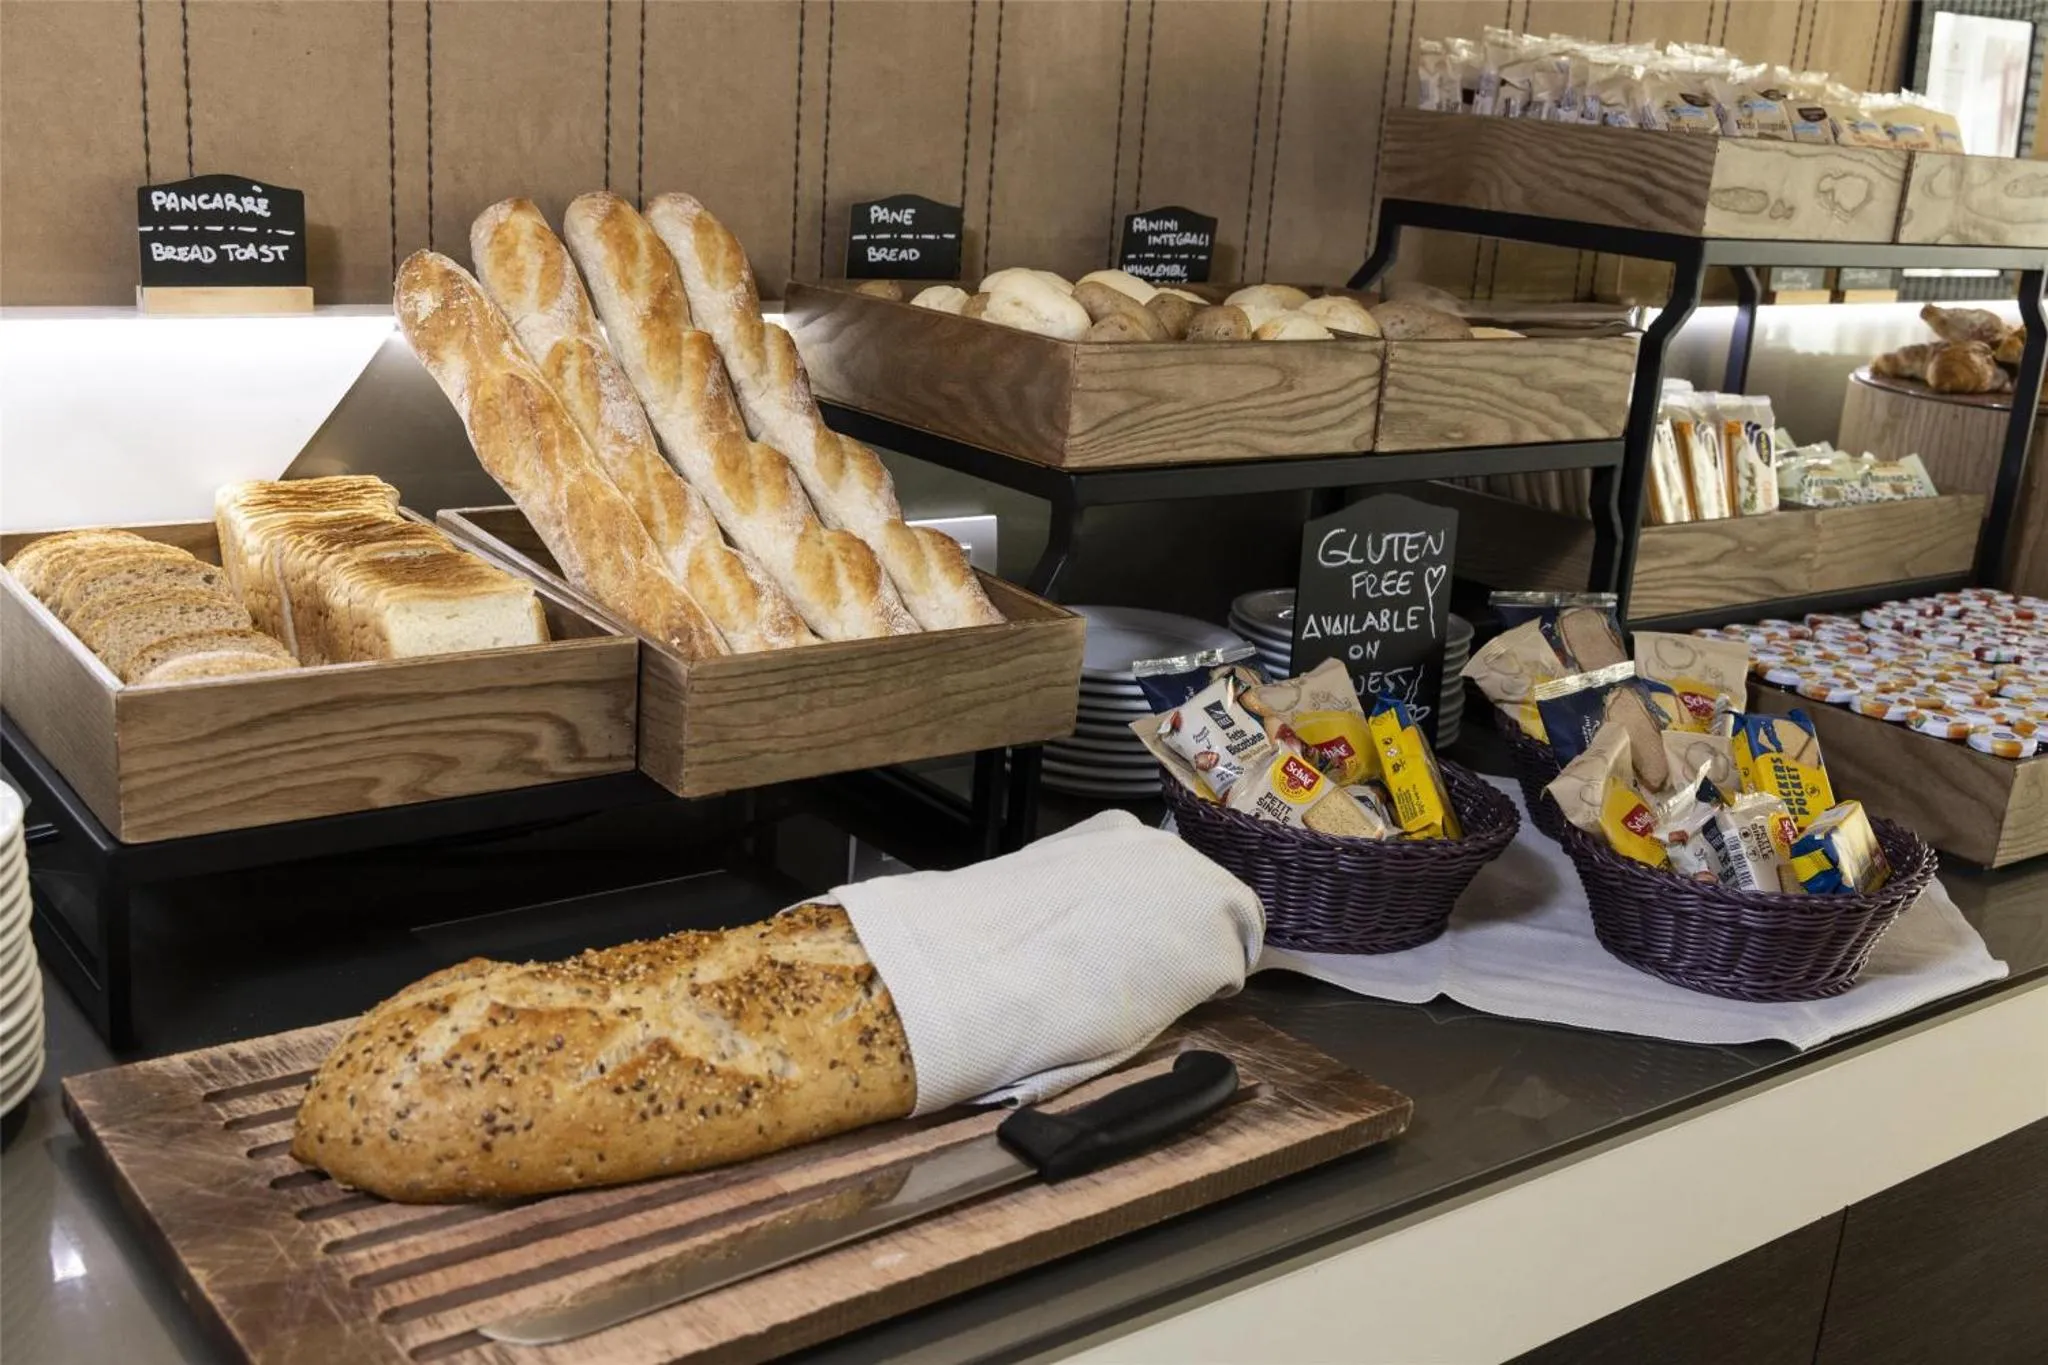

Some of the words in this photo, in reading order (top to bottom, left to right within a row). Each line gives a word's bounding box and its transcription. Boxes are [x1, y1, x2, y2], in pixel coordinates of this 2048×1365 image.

[869, 205, 916, 225] PANE
[1133, 217, 1178, 233] PANINI
[1148, 231, 1209, 247] INTEGRALI
[151, 242, 217, 263] BREAD
[220, 242, 289, 263] TOAST
[867, 246, 921, 262] BREAD
[1318, 528, 1445, 567] GLUTEN
[1351, 570, 1415, 600] FREE
[1302, 606, 1425, 640] AVAILABLE
[1348, 640, 1380, 661] ON
[1786, 765, 1810, 815] POCKET
[1256, 796, 1290, 826] SINGLE
[1264, 791, 1292, 815] PETIT
